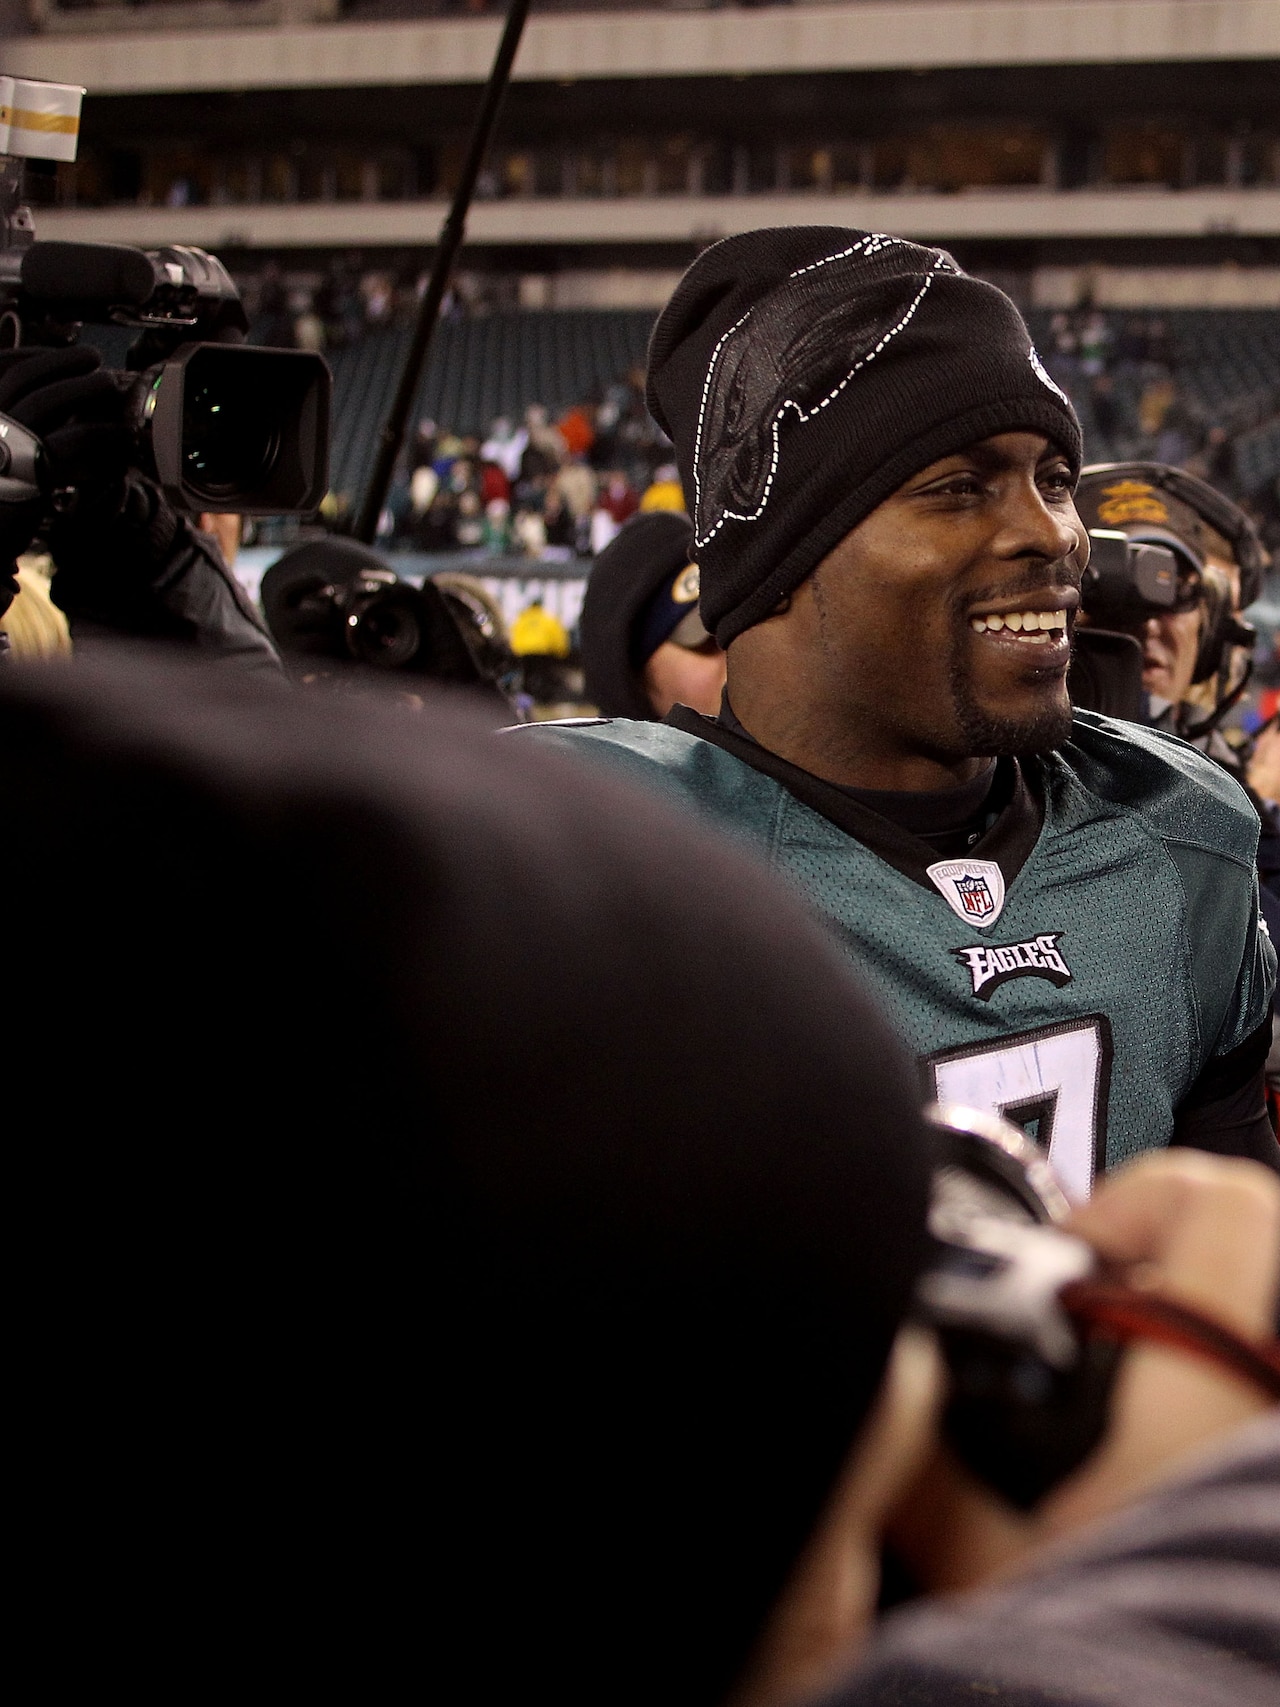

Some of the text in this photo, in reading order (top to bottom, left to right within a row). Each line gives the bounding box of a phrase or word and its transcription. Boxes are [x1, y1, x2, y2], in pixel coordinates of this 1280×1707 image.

[935, 864, 996, 879] EQUIPMENT
[962, 890, 993, 913] NFL
[957, 933, 1072, 995] EAGLES
[925, 1018, 1108, 1205] 7
